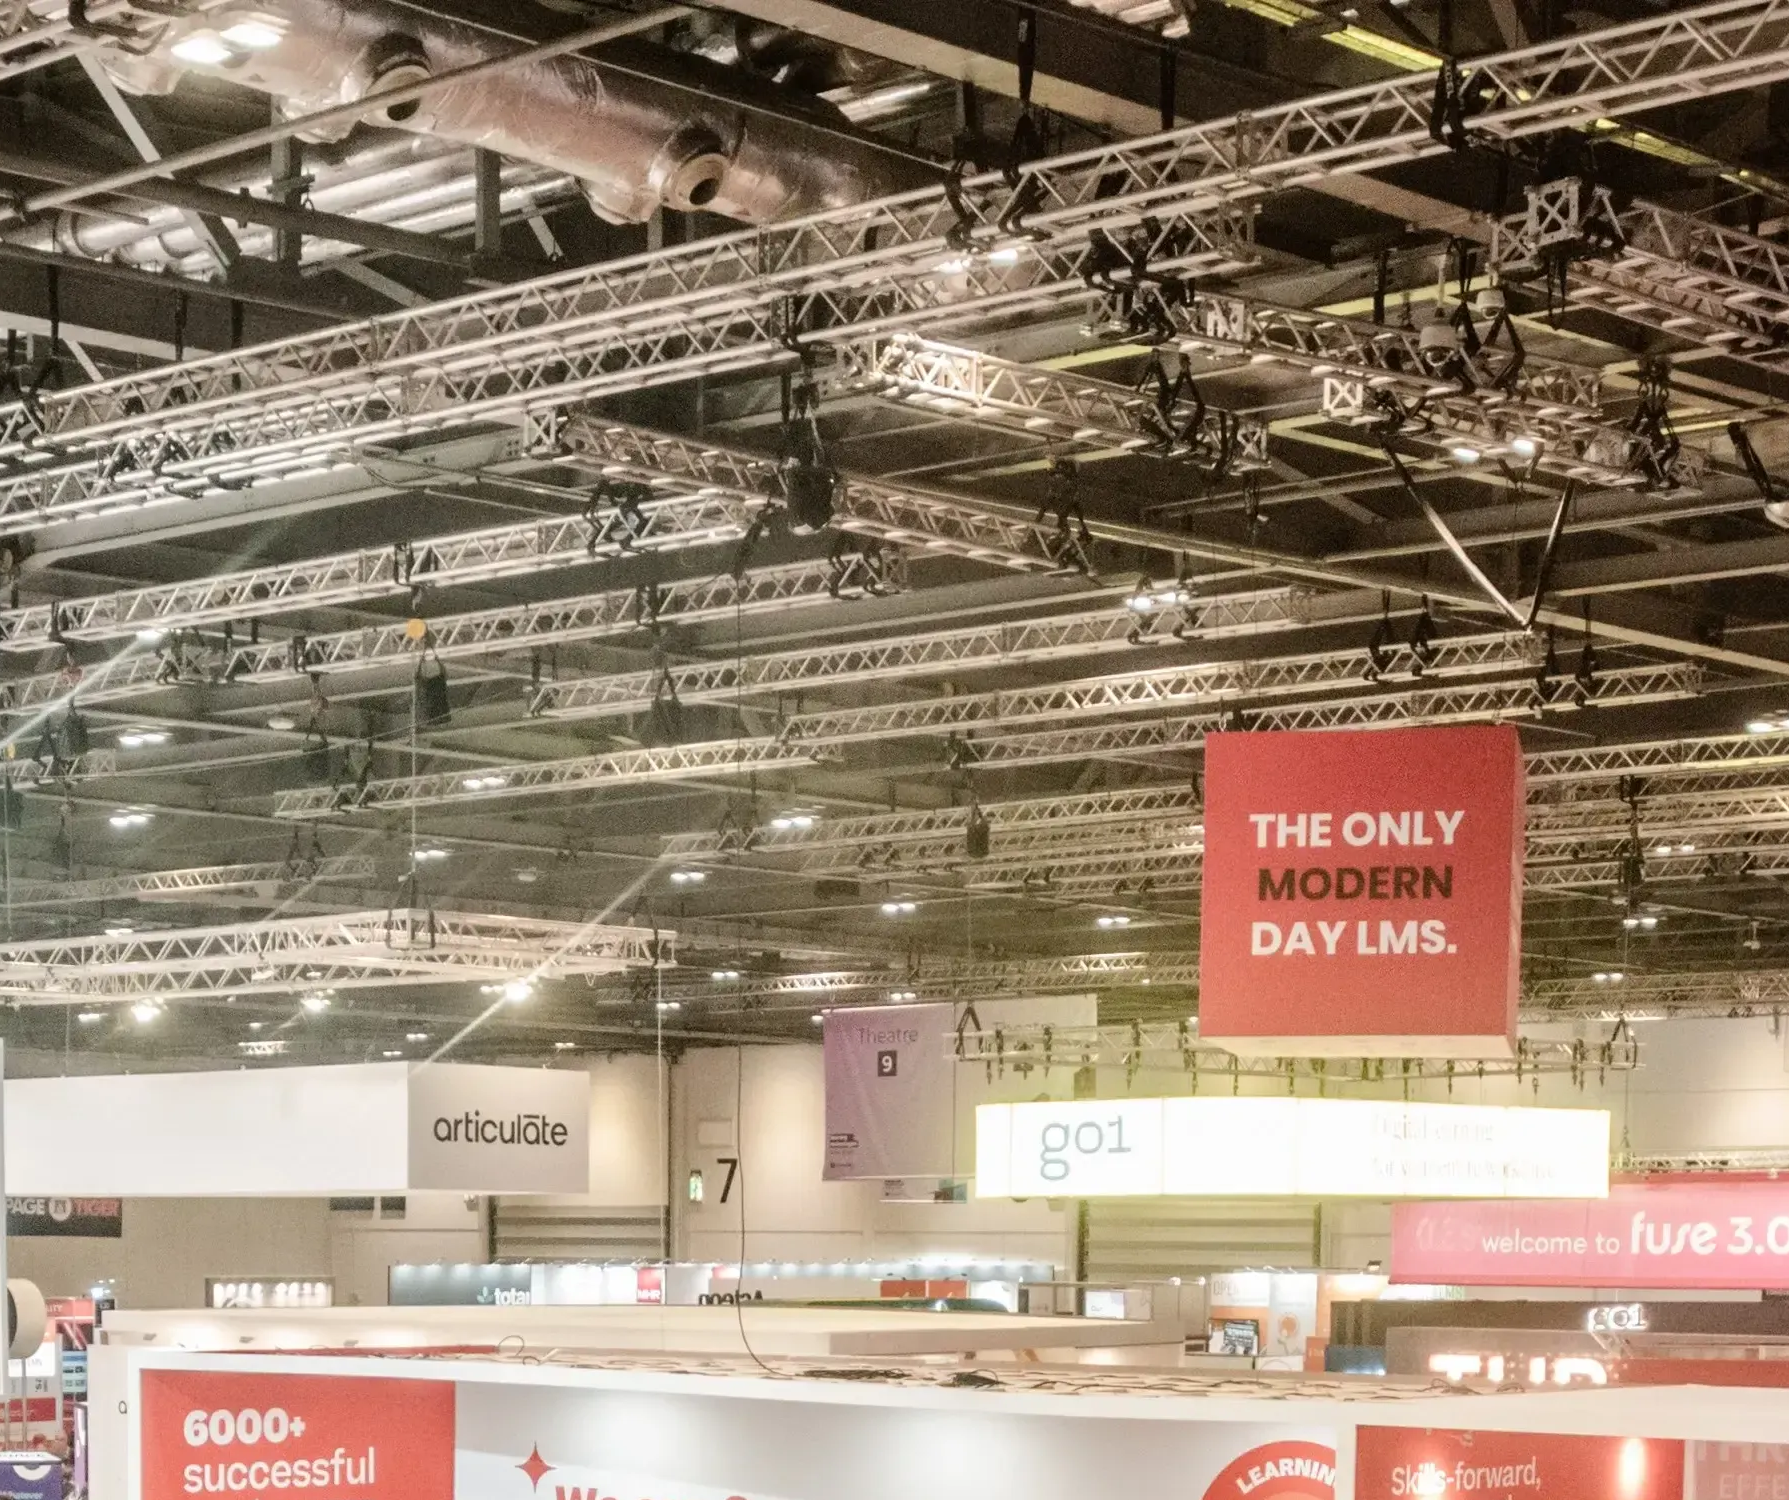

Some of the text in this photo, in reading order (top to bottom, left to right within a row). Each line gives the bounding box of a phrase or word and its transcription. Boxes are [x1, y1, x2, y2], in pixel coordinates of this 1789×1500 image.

[1250, 809, 1465, 848] THE ONLY
[1257, 865, 1454, 902] MODERN
[1251, 918, 1458, 957] DAY LMS.
[857, 1025, 919, 1046] Theatre
[881, 1055, 893, 1074] 9
[1039, 1115, 1132, 1183] go1
[715, 1158, 737, 1203] 7
[1482, 1230, 1588, 1256] welcome
[1593, 1233, 1620, 1256] to
[1630, 1212, 1718, 1257] fuse
[183, 1407, 306, 1447] 6000+
[183, 1447, 376, 1493] successful
[1235, 1457, 1336, 1496] LEARNIN
[1391, 1456, 1541, 1496] Skills-forward,
